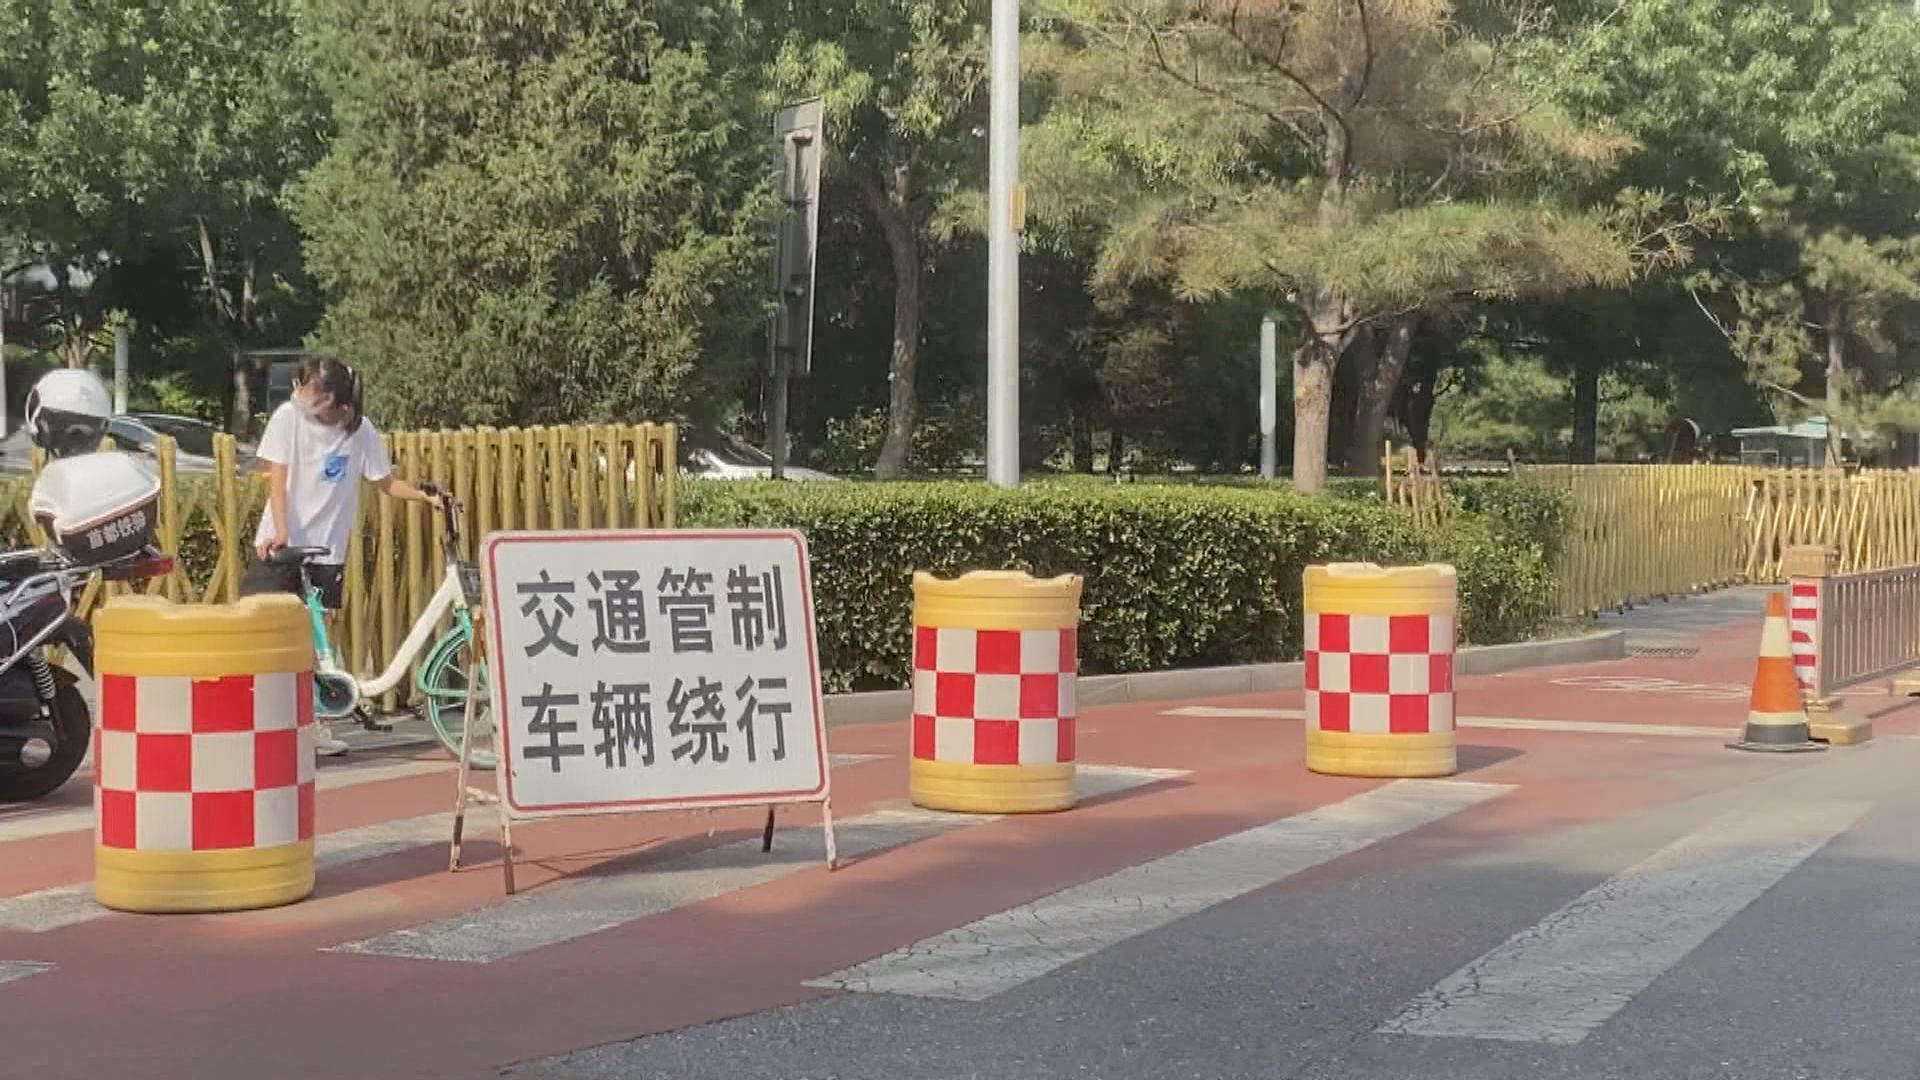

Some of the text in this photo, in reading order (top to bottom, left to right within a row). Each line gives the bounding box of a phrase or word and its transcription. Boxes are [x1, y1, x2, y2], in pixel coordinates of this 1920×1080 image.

[516, 564, 788, 658] 交通管制
[520, 675, 792, 773] 车辆绕行
